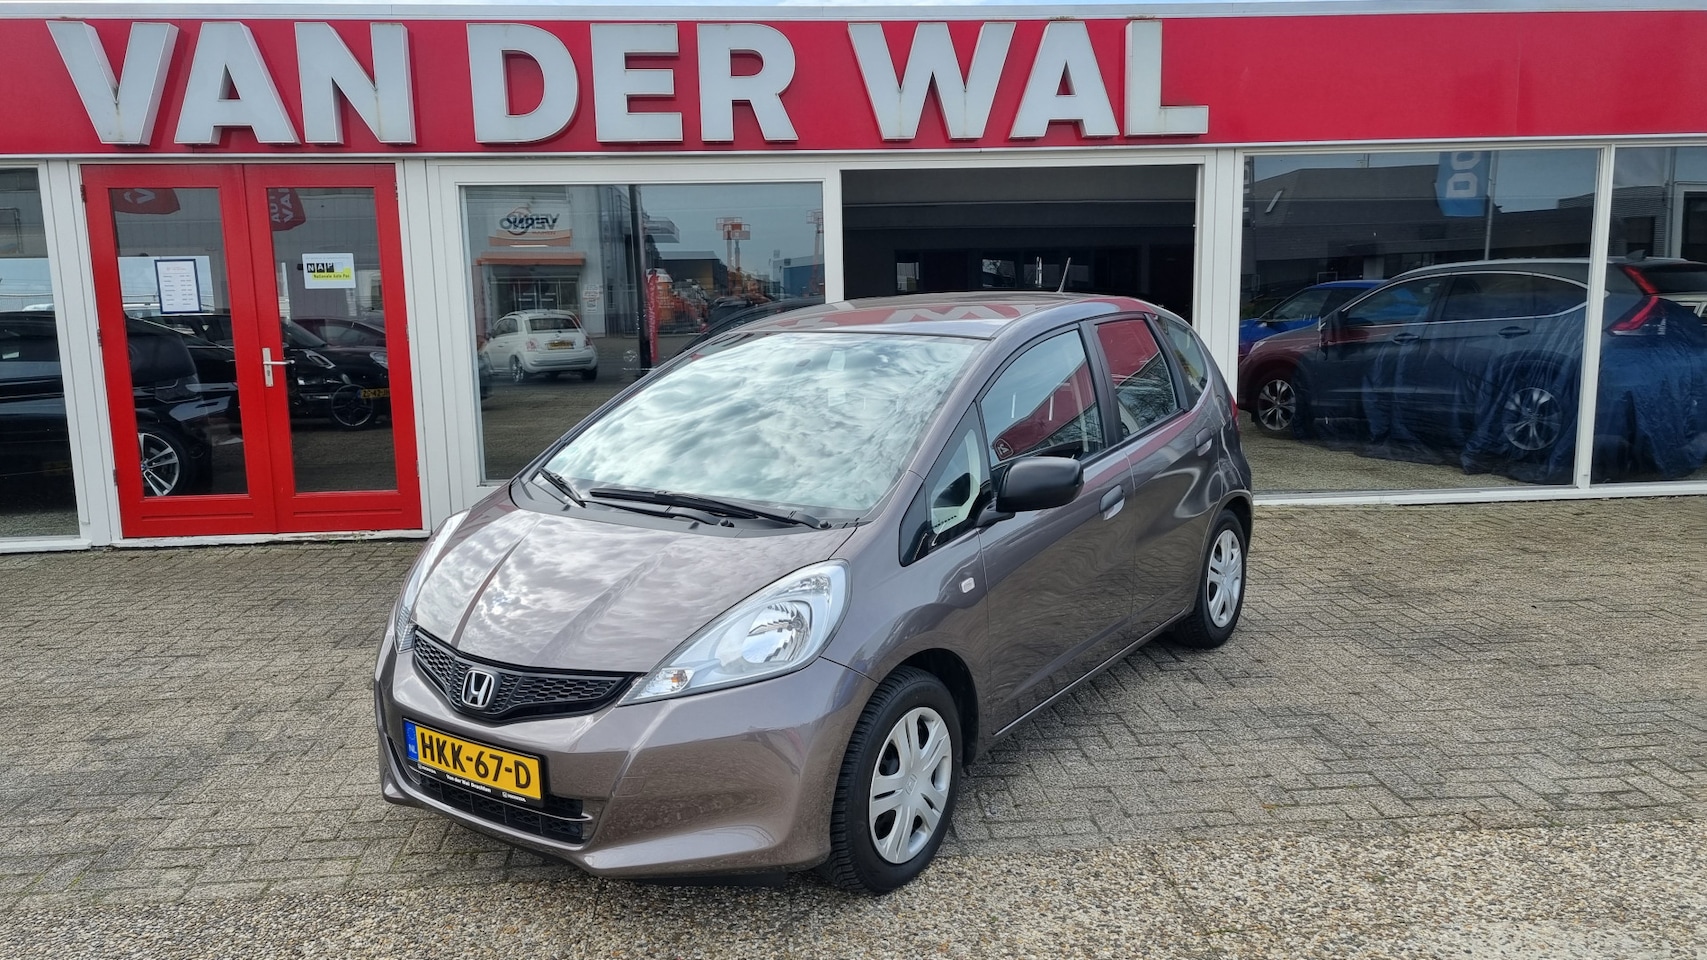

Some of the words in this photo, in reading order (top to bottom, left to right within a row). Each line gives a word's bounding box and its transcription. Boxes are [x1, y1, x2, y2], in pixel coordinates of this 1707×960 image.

[45, 20, 416, 145] VAN
[466, 22, 799, 143] DER
[847, 20, 1209, 141] WAL
[306, 262, 334, 273] NAP
[408, 743, 418, 754] NL
[420, 732, 531, 789] HKK-67-D
